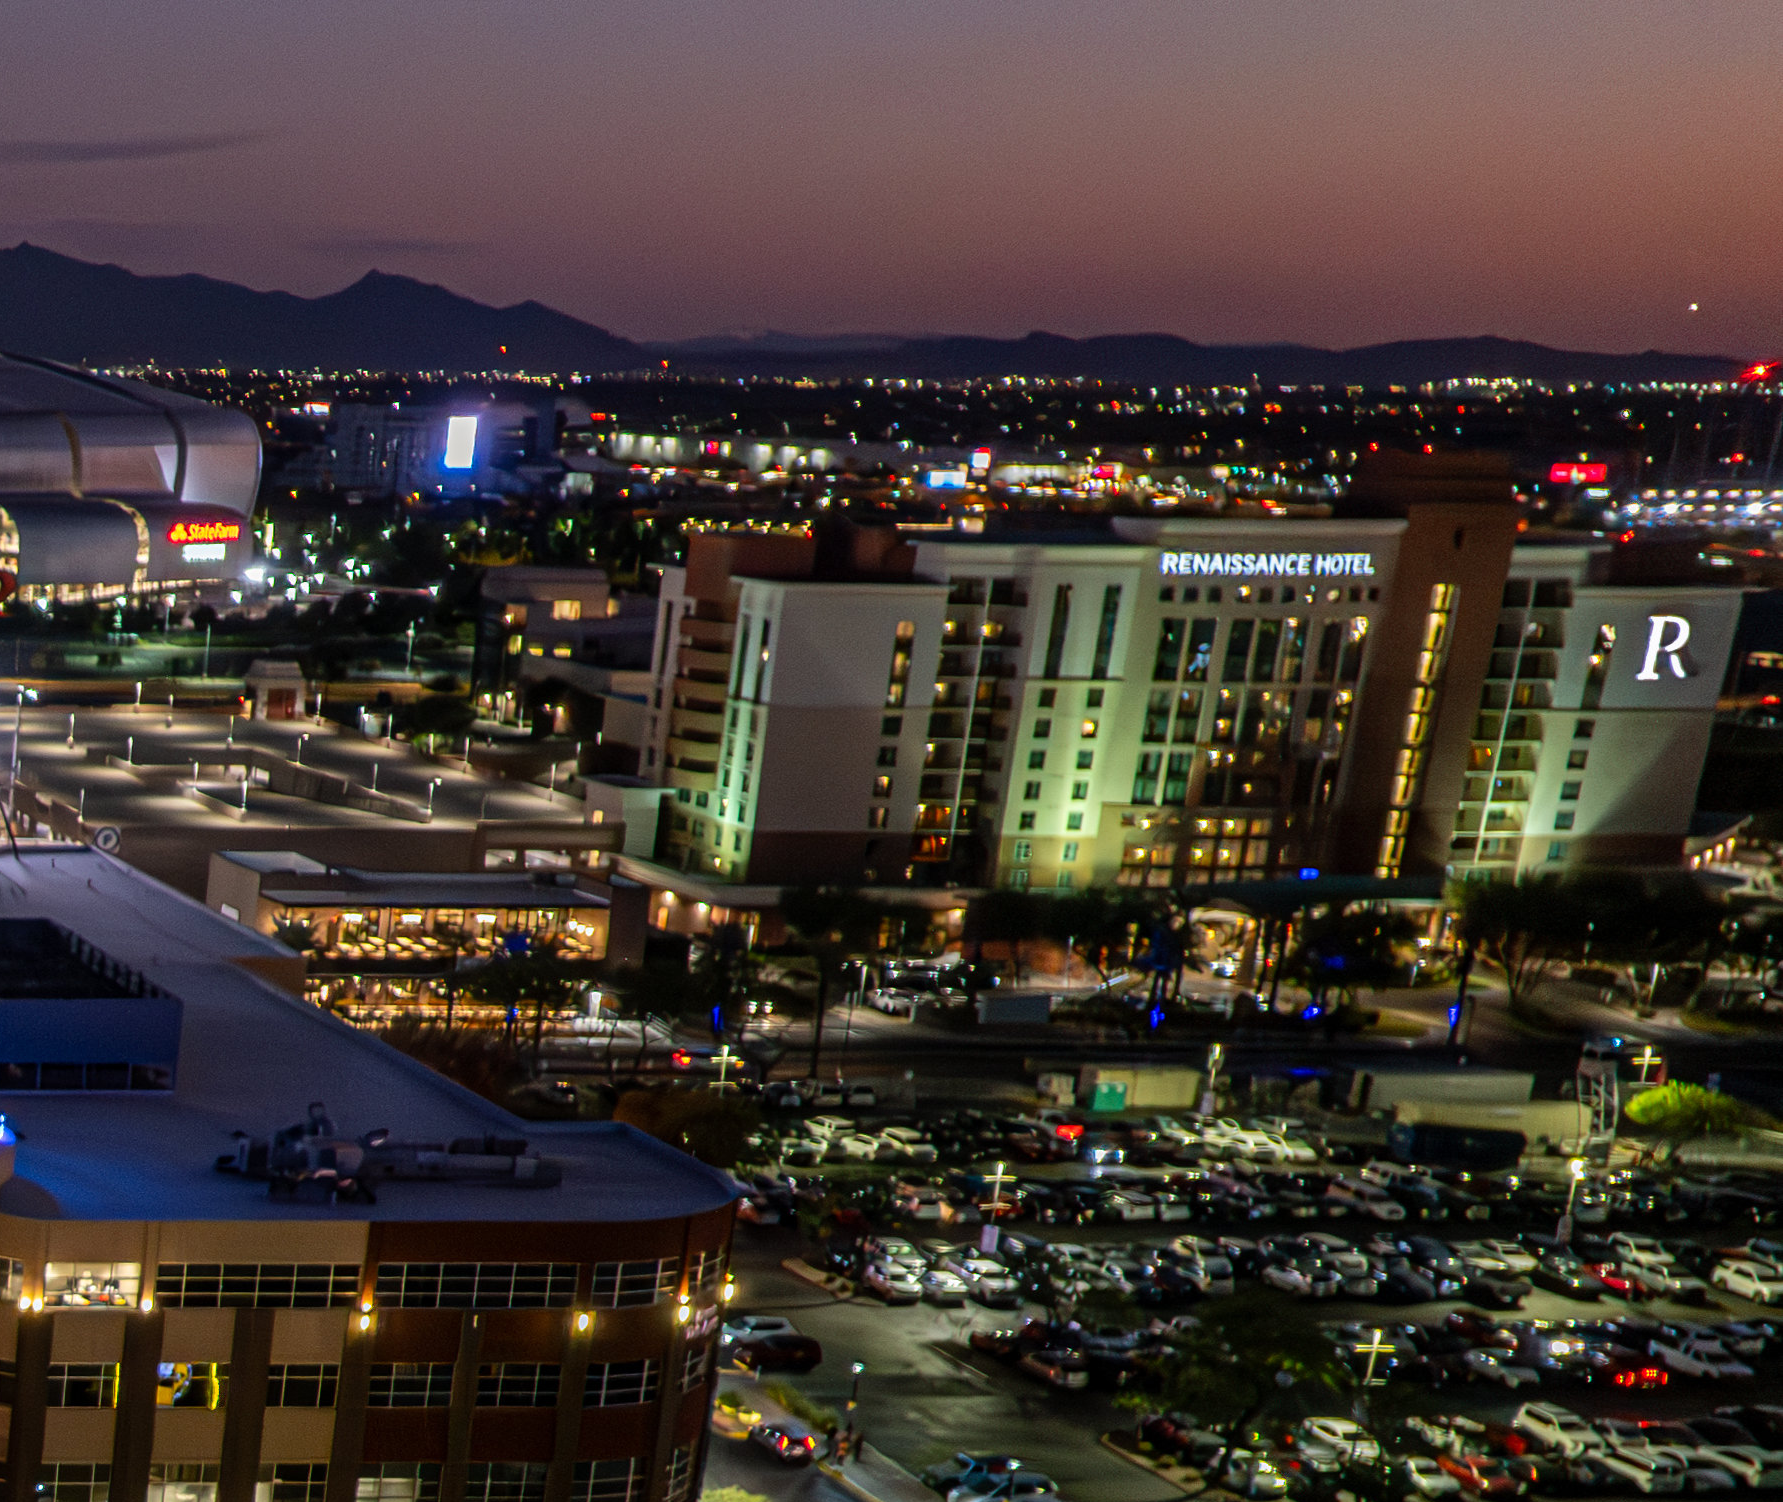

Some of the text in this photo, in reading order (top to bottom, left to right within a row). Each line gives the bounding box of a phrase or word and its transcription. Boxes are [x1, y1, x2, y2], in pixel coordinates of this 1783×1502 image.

[1162, 552, 1375, 576] RENAISSANCE HOTEL
[1636, 615, 1690, 680] R
